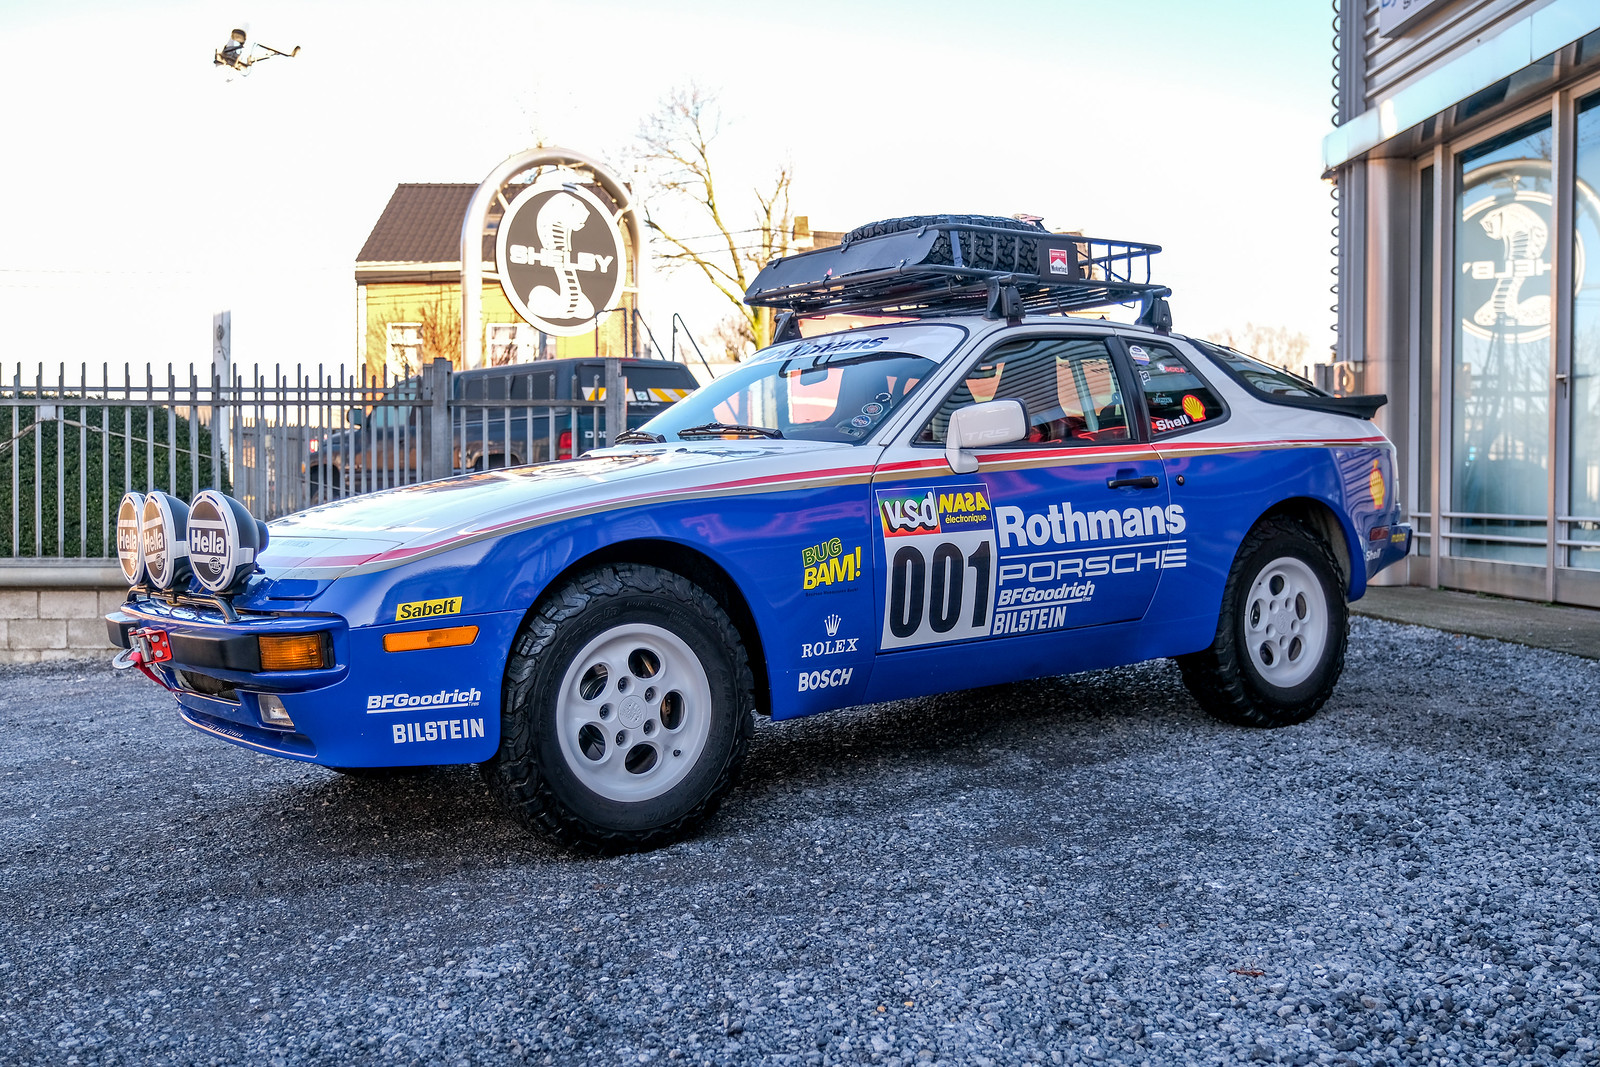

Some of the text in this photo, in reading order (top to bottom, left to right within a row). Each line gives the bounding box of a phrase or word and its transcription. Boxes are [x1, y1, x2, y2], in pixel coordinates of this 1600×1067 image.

[510, 244, 614, 273] SHELBY
[965, 428, 1010, 440] TRS
[1155, 415, 1189, 430] Shell
[945, 513, 987, 524] électronique
[995, 501, 1186, 548] Rothmans
[119, 529, 138, 550] Hella
[144, 528, 164, 552] Hella
[191, 529, 225, 554] Hella
[801, 537, 842, 568] BUG
[803, 546, 861, 590] BAM!
[998, 548, 1187, 585] PORSCHE
[889, 541, 991, 639] 001
[997, 580, 1095, 607] BFGoodrich
[400, 599, 456, 619] Sabelt
[993, 606, 1068, 636] BILSTEIN
[801, 638, 860, 658] ROLEX
[798, 667, 853, 692] BOSCH
[367, 687, 481, 710] BFGoodrich
[392, 718, 485, 744] BILSTEIN
